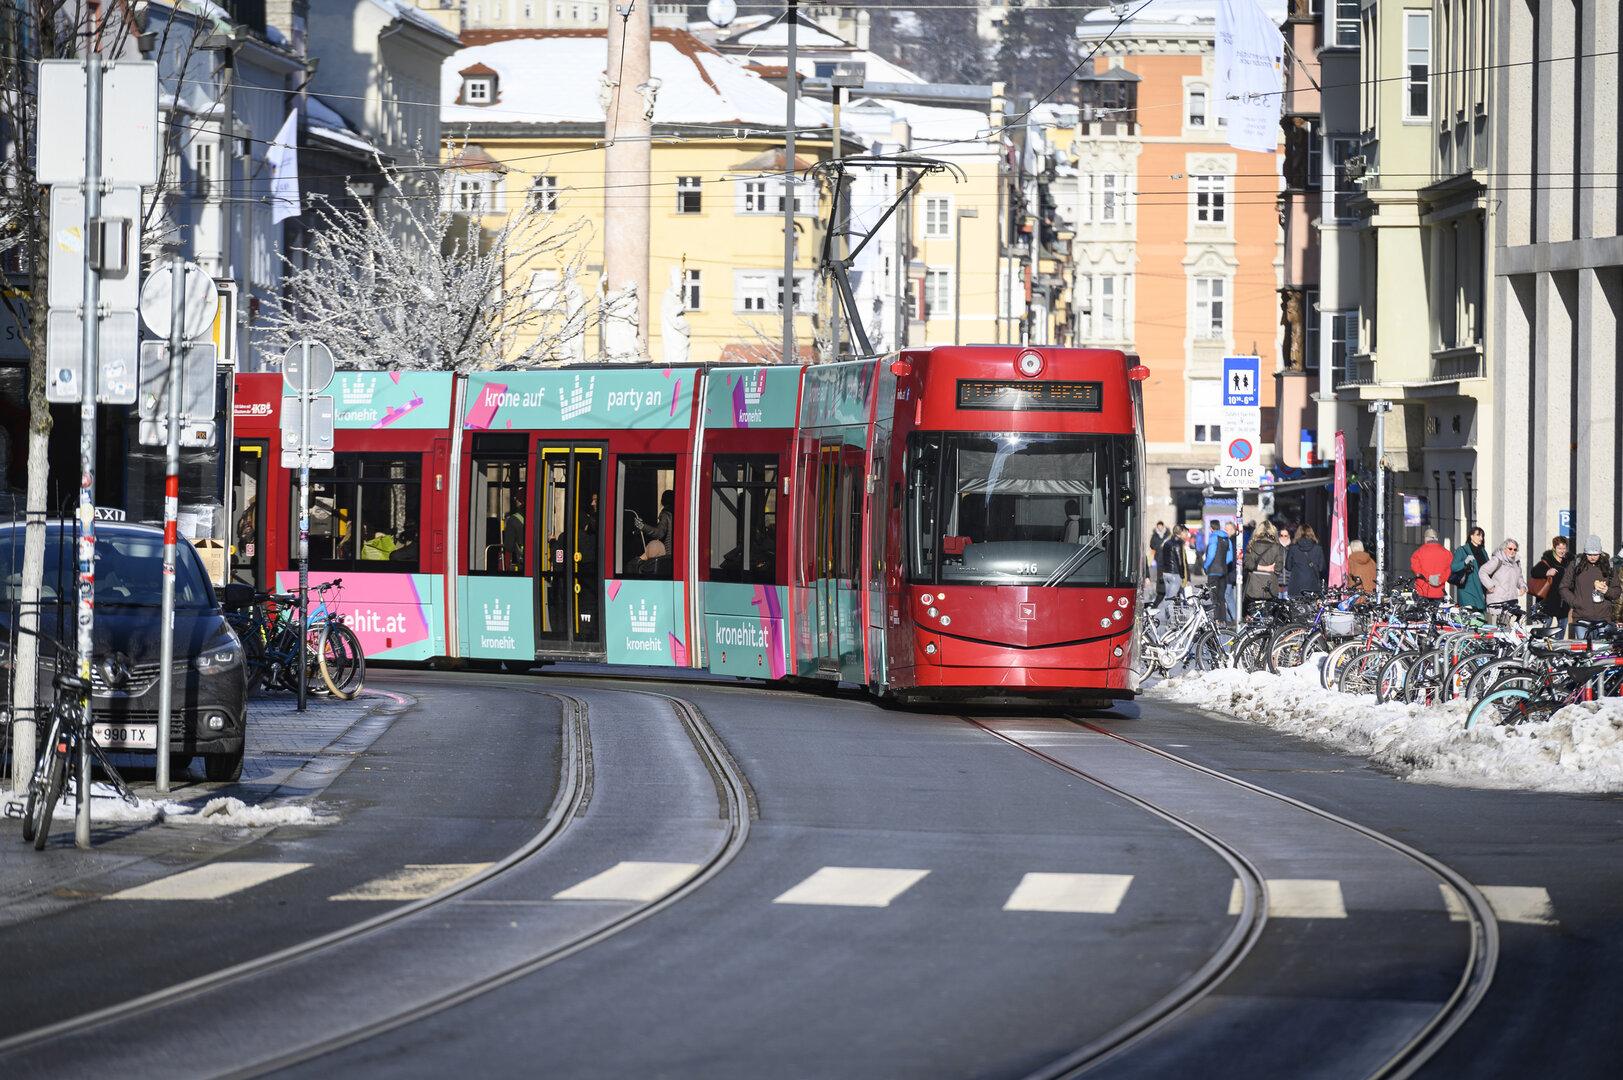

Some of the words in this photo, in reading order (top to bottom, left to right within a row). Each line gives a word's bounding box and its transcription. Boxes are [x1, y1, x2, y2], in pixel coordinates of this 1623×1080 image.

[484, 388, 520, 407] krone
[522, 388, 545, 407] auf
[607, 388, 642, 411] party
[646, 391, 662, 406] an
[335, 408, 378, 421] kronehit
[738, 409, 762, 422] kronehit
[1226, 465, 1254, 477] Zone
[94, 509, 119, 521] AXI
[1016, 563, 1038, 573] 316
[344, 609, 406, 633] ehit.at
[716, 620, 769, 648] kronehit.at
[481, 635, 516, 649] kronehit
[626, 636, 663, 651] kronehit
[104, 728, 127, 741] 990
[131, 729, 146, 741] TX
